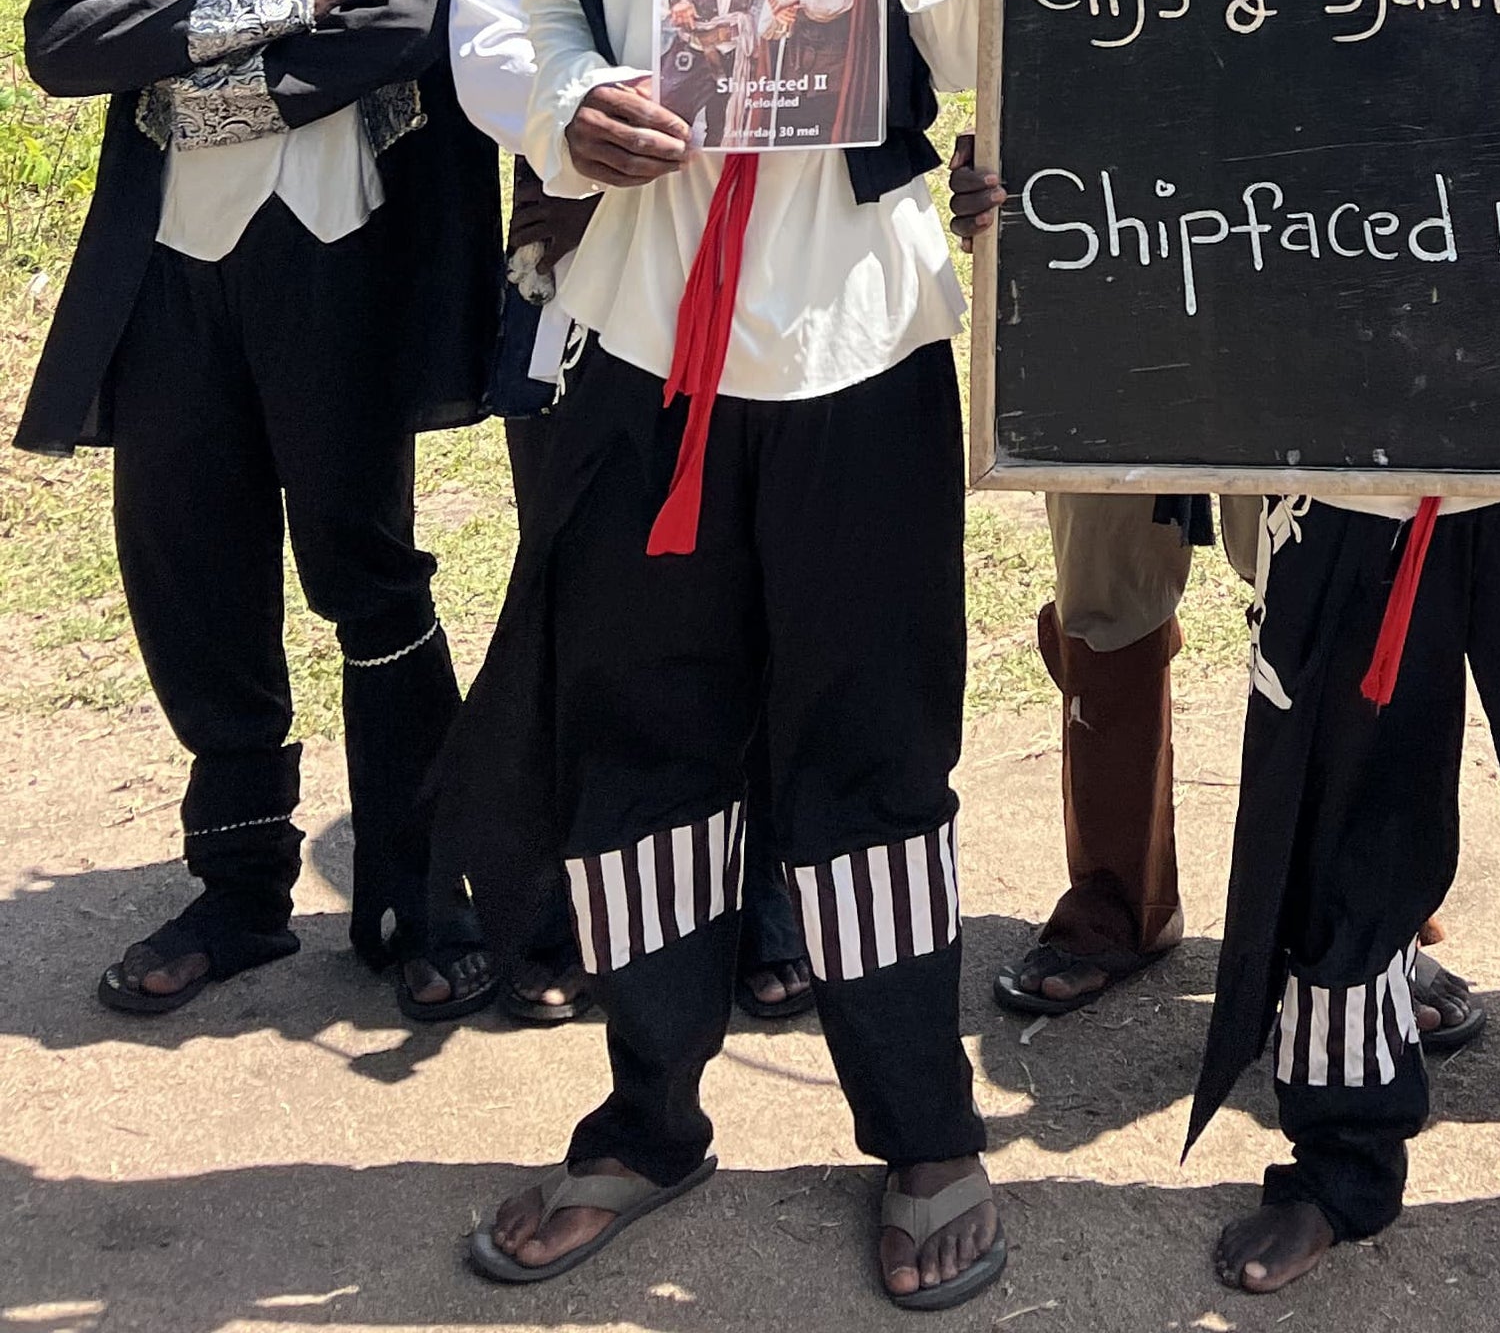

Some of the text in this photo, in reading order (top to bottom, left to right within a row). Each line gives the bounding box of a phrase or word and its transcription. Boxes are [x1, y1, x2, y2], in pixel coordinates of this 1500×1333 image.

[814, 74, 827, 90] II
[779, 126, 794, 137] 30
[797, 124, 819, 136] mei
[1022, 168, 1458, 316] Shipfaced
